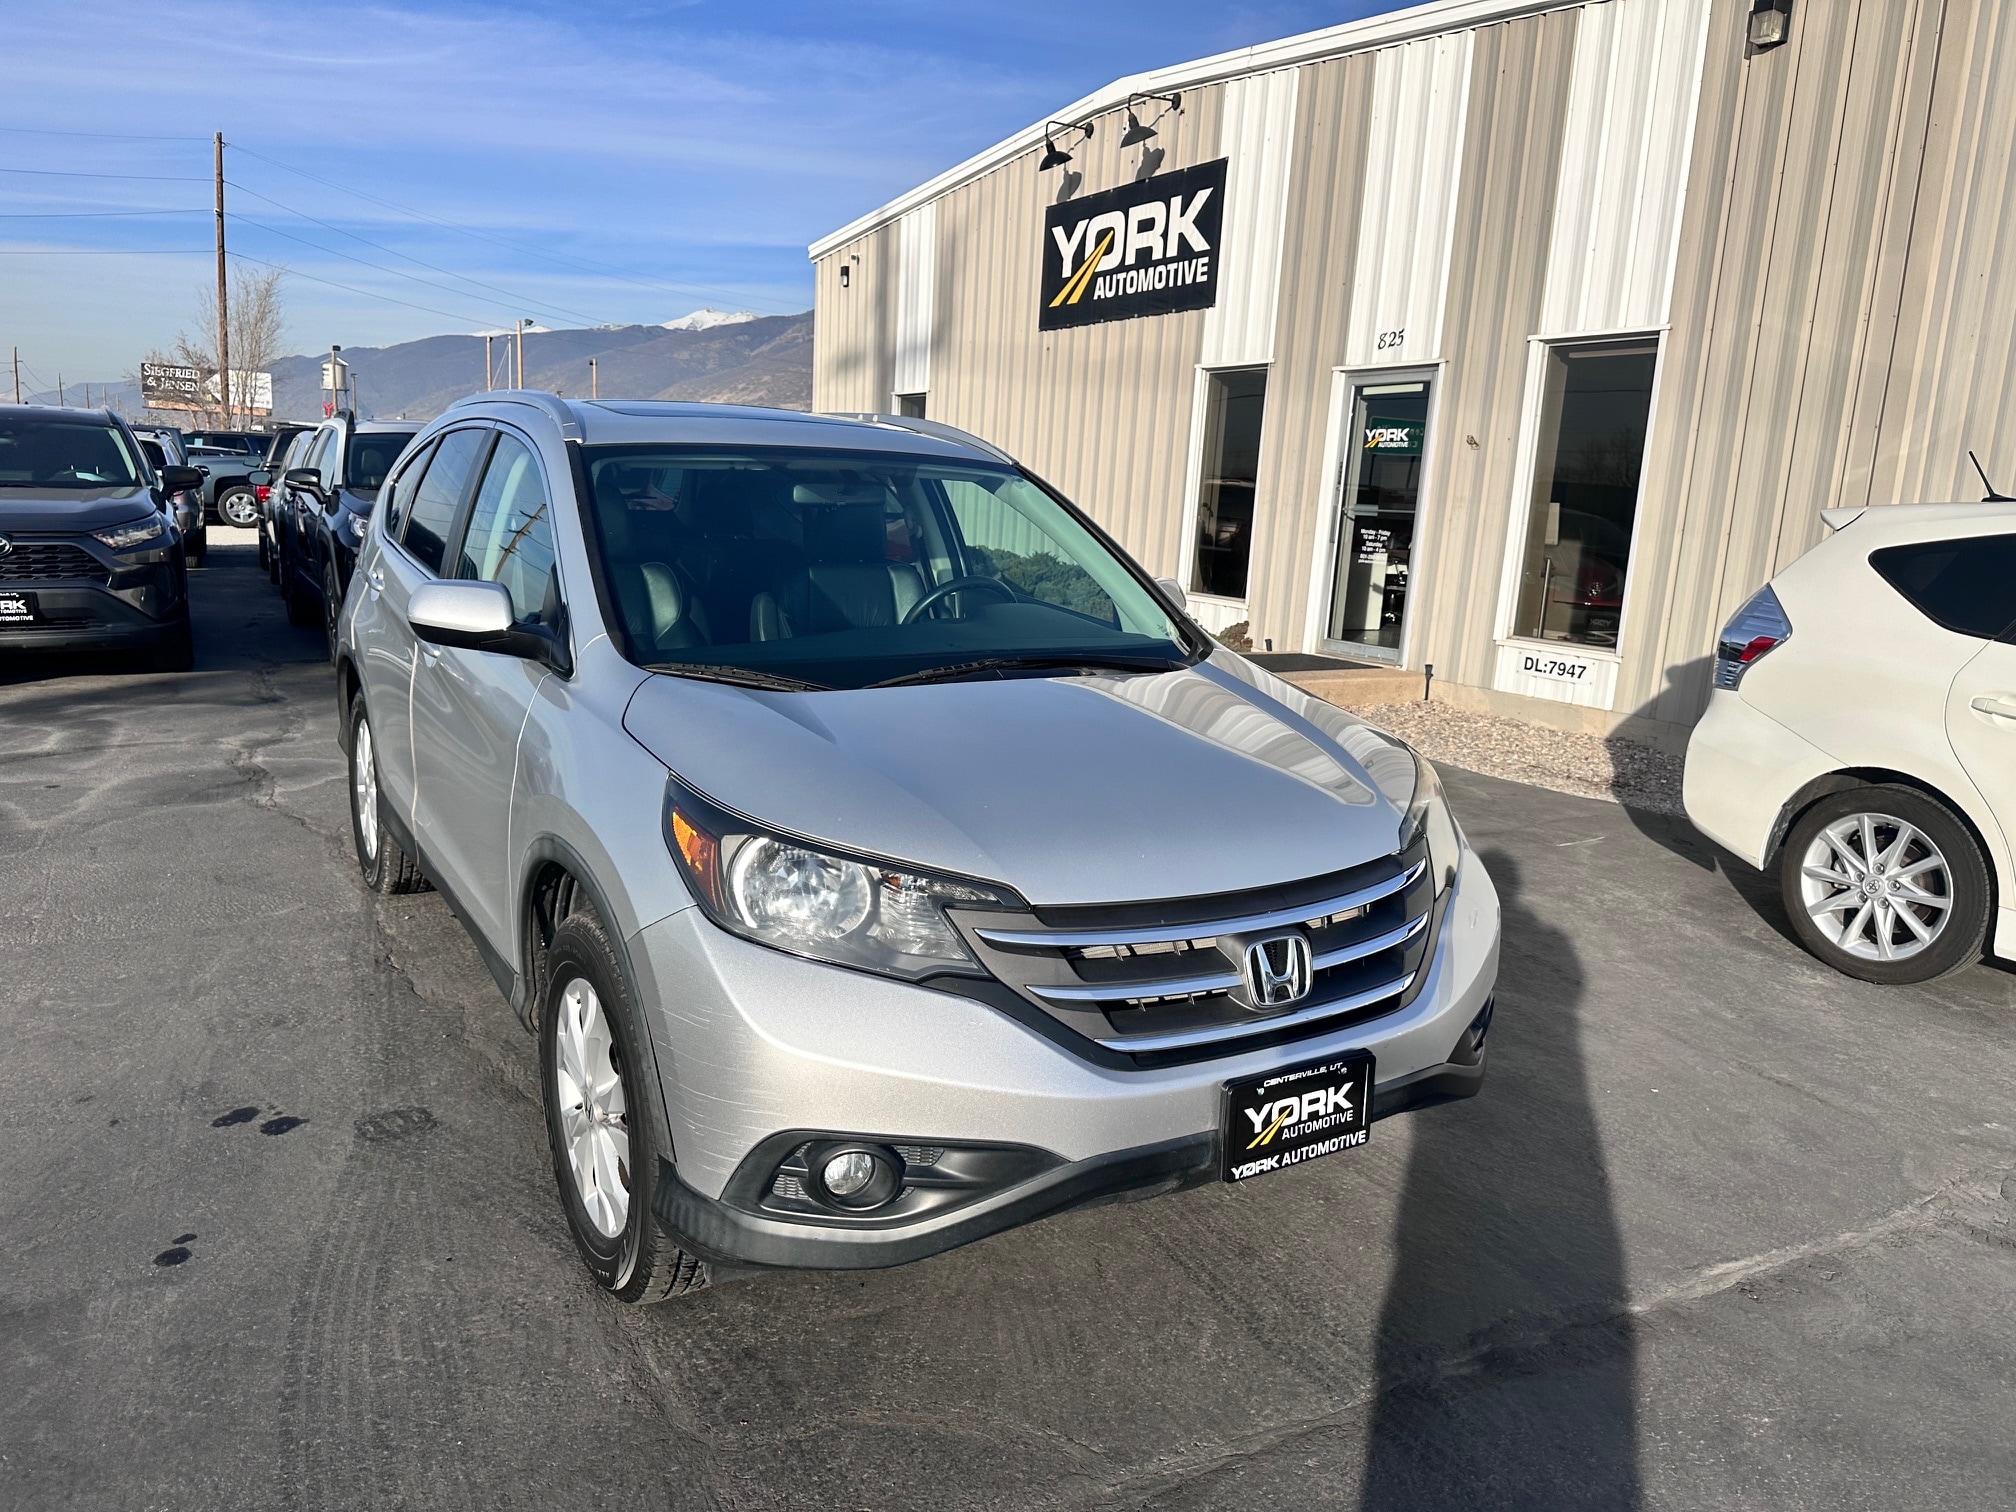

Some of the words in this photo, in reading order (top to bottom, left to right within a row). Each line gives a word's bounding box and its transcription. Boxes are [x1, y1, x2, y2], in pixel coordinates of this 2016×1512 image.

[1051, 187, 1213, 278] YORK
[1093, 256, 1209, 300] AUTOMOTIVE
[1378, 328, 1405, 350] 825
[144, 363, 200, 379] SIEGFRIED
[147, 376, 157, 387] &
[159, 377, 200, 392] JENSEN
[1365, 428, 1410, 442] YORK
[1366, 540, 1383, 548] Saturday
[1524, 656, 1587, 679] DL:7947
[1264, 1066, 1327, 1088] CENTERVILLE,
[1244, 1082, 1354, 1134] YORK
[1282, 1110, 1354, 1140] AUTOMOTIVE
[1231, 1154, 1280, 1180] YORK
[1282, 1130, 1367, 1167] AUTOMOTIVE
